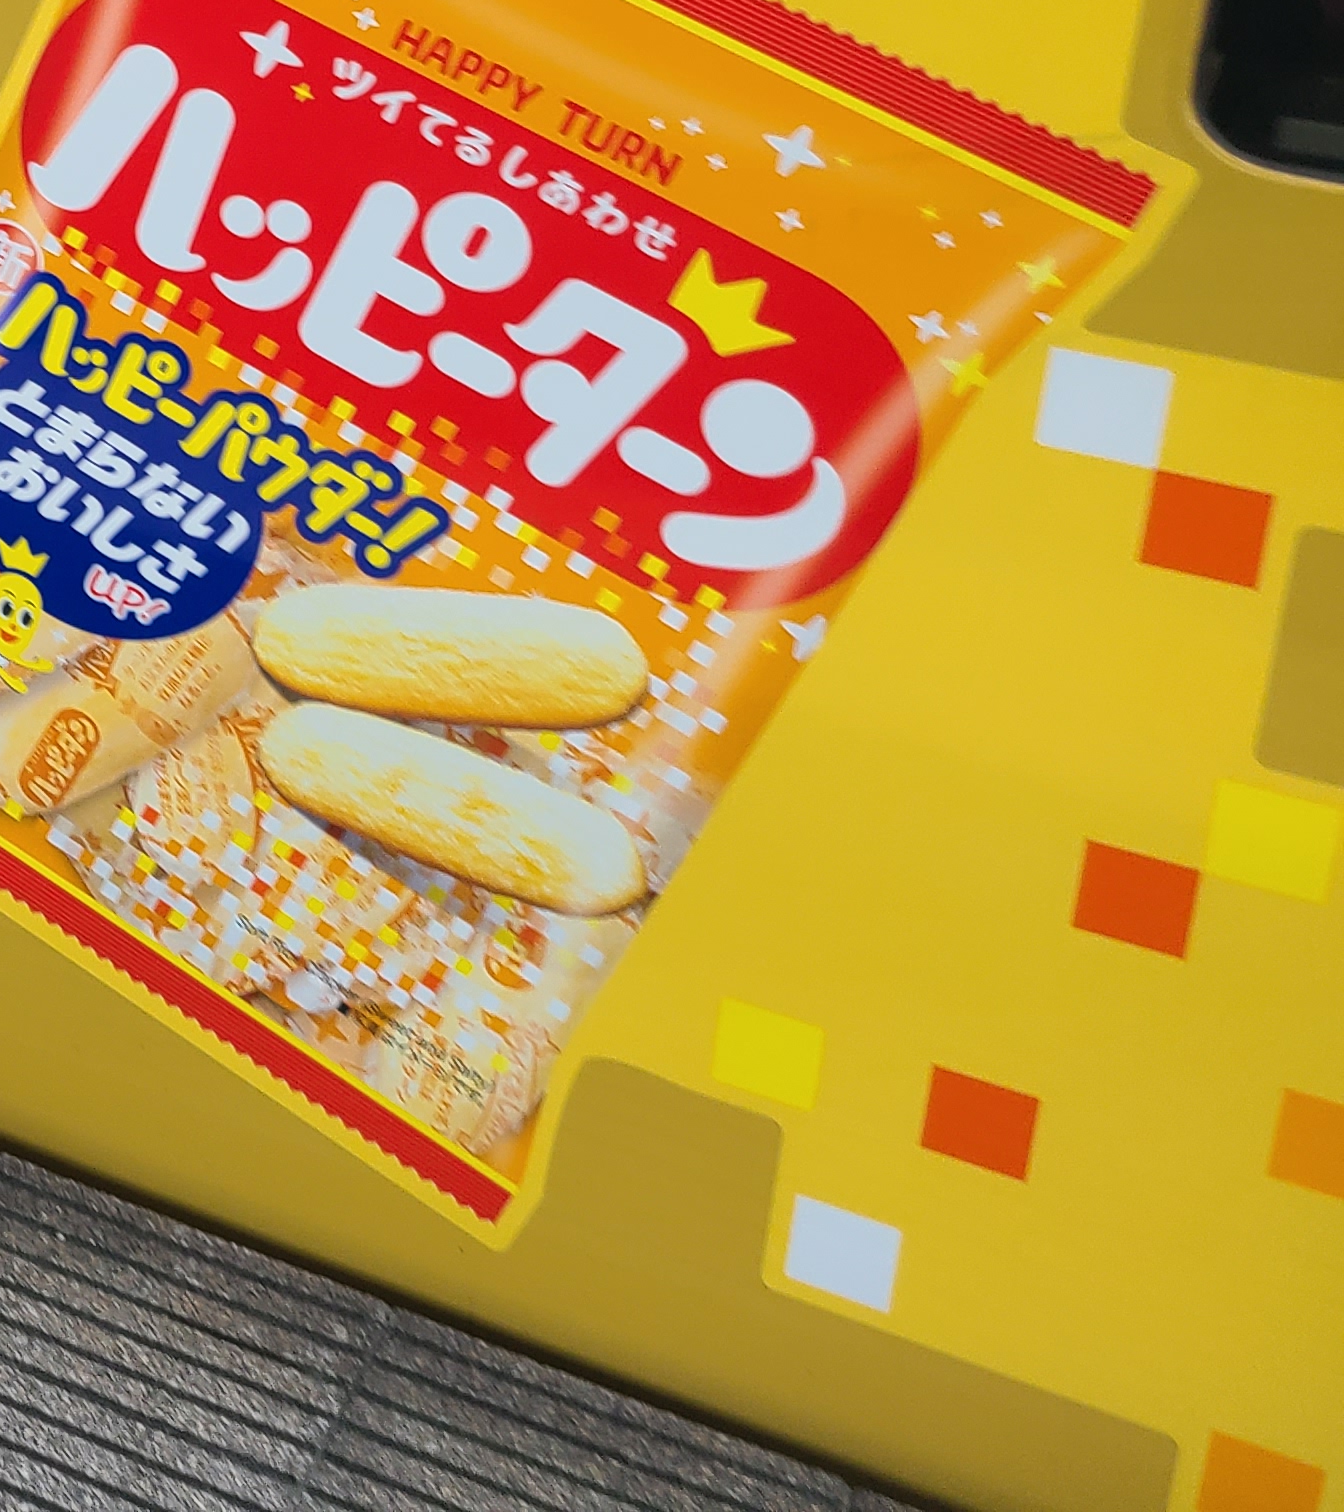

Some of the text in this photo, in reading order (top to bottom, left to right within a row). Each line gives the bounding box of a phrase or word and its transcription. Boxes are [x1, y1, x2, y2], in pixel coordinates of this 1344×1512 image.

[331, 56, 679, 262] ツイてるしあわせ
[390, 18, 683, 187] HAPPY TURN
[26, 43, 847, 572] ハッピーターン
